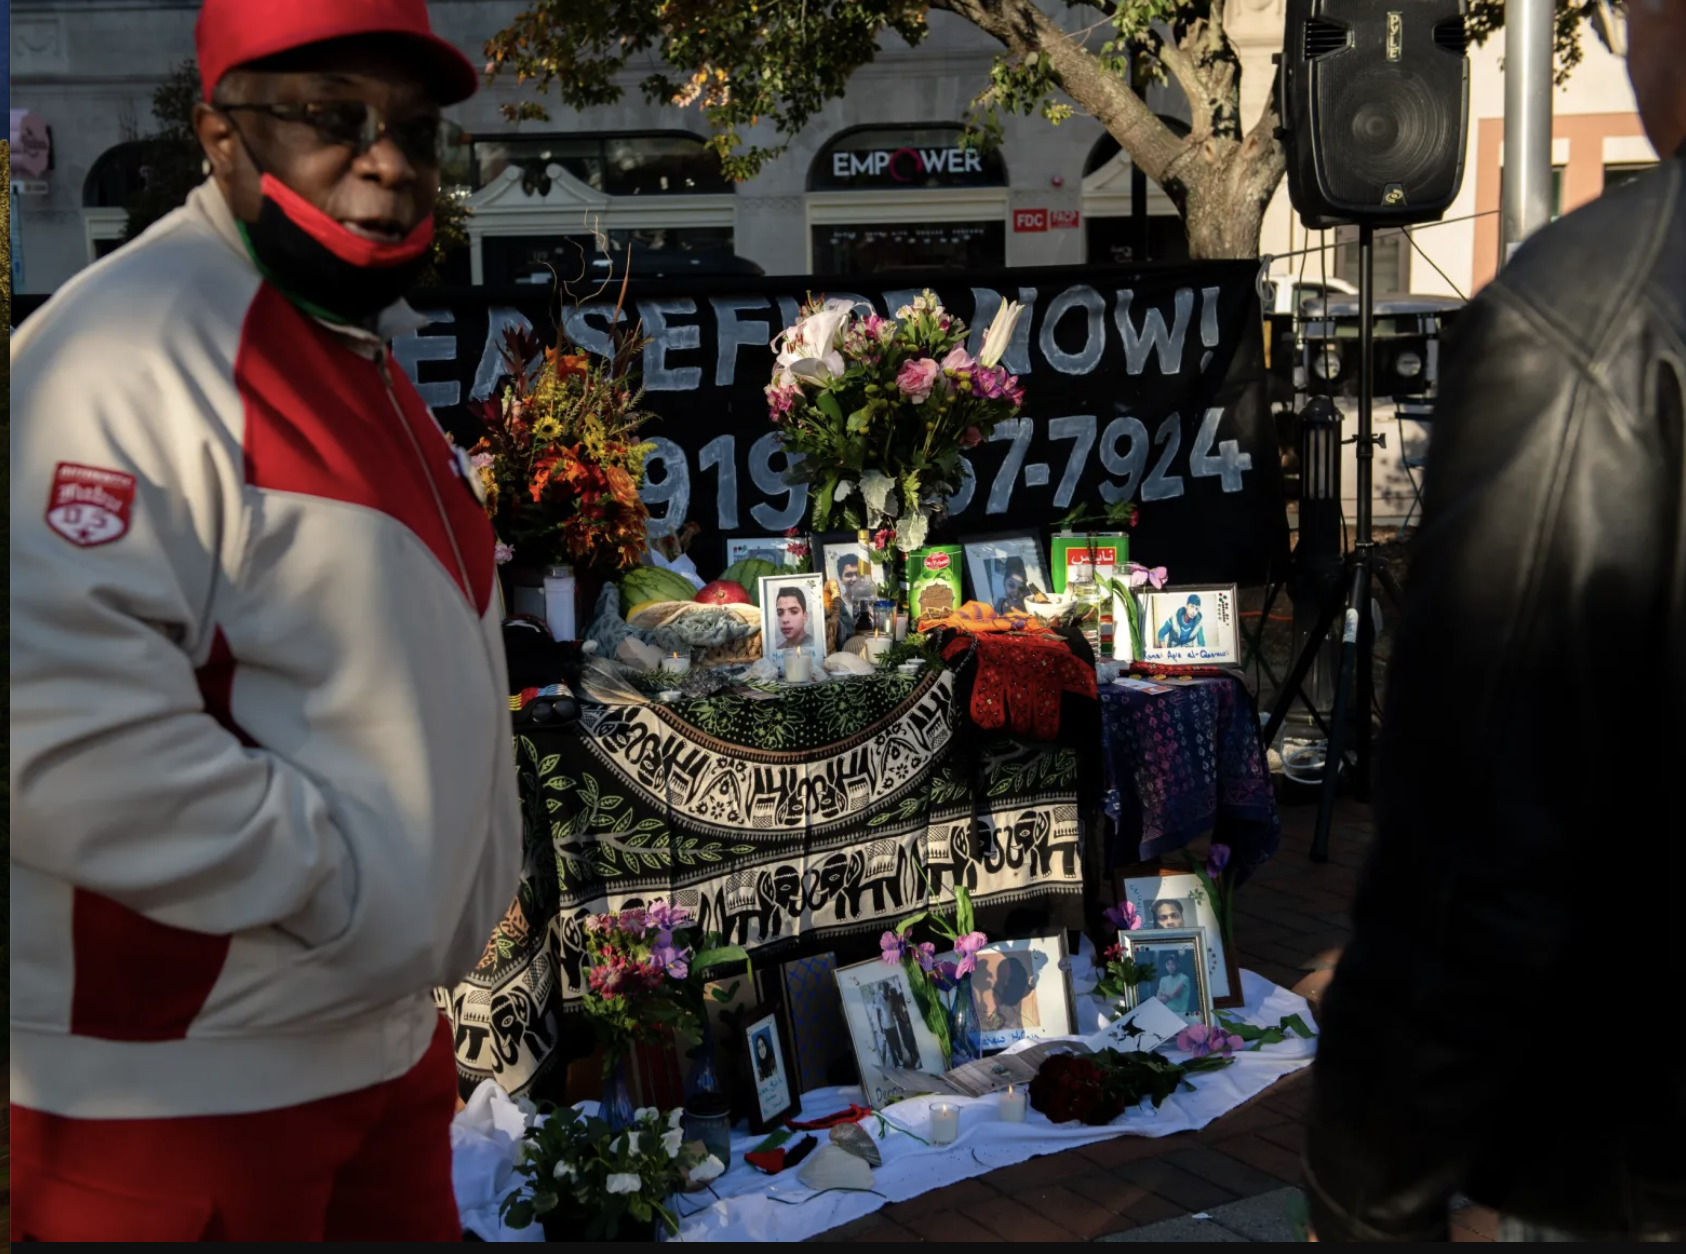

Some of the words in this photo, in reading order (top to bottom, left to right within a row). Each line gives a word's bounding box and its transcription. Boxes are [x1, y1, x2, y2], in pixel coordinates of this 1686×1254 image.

[1389, 14, 1399, 58] PYLE
[832, 147, 983, 183] EMPOWER
[1016, 213, 1044, 227] FDC
[966, 284, 1220, 375] NOW!
